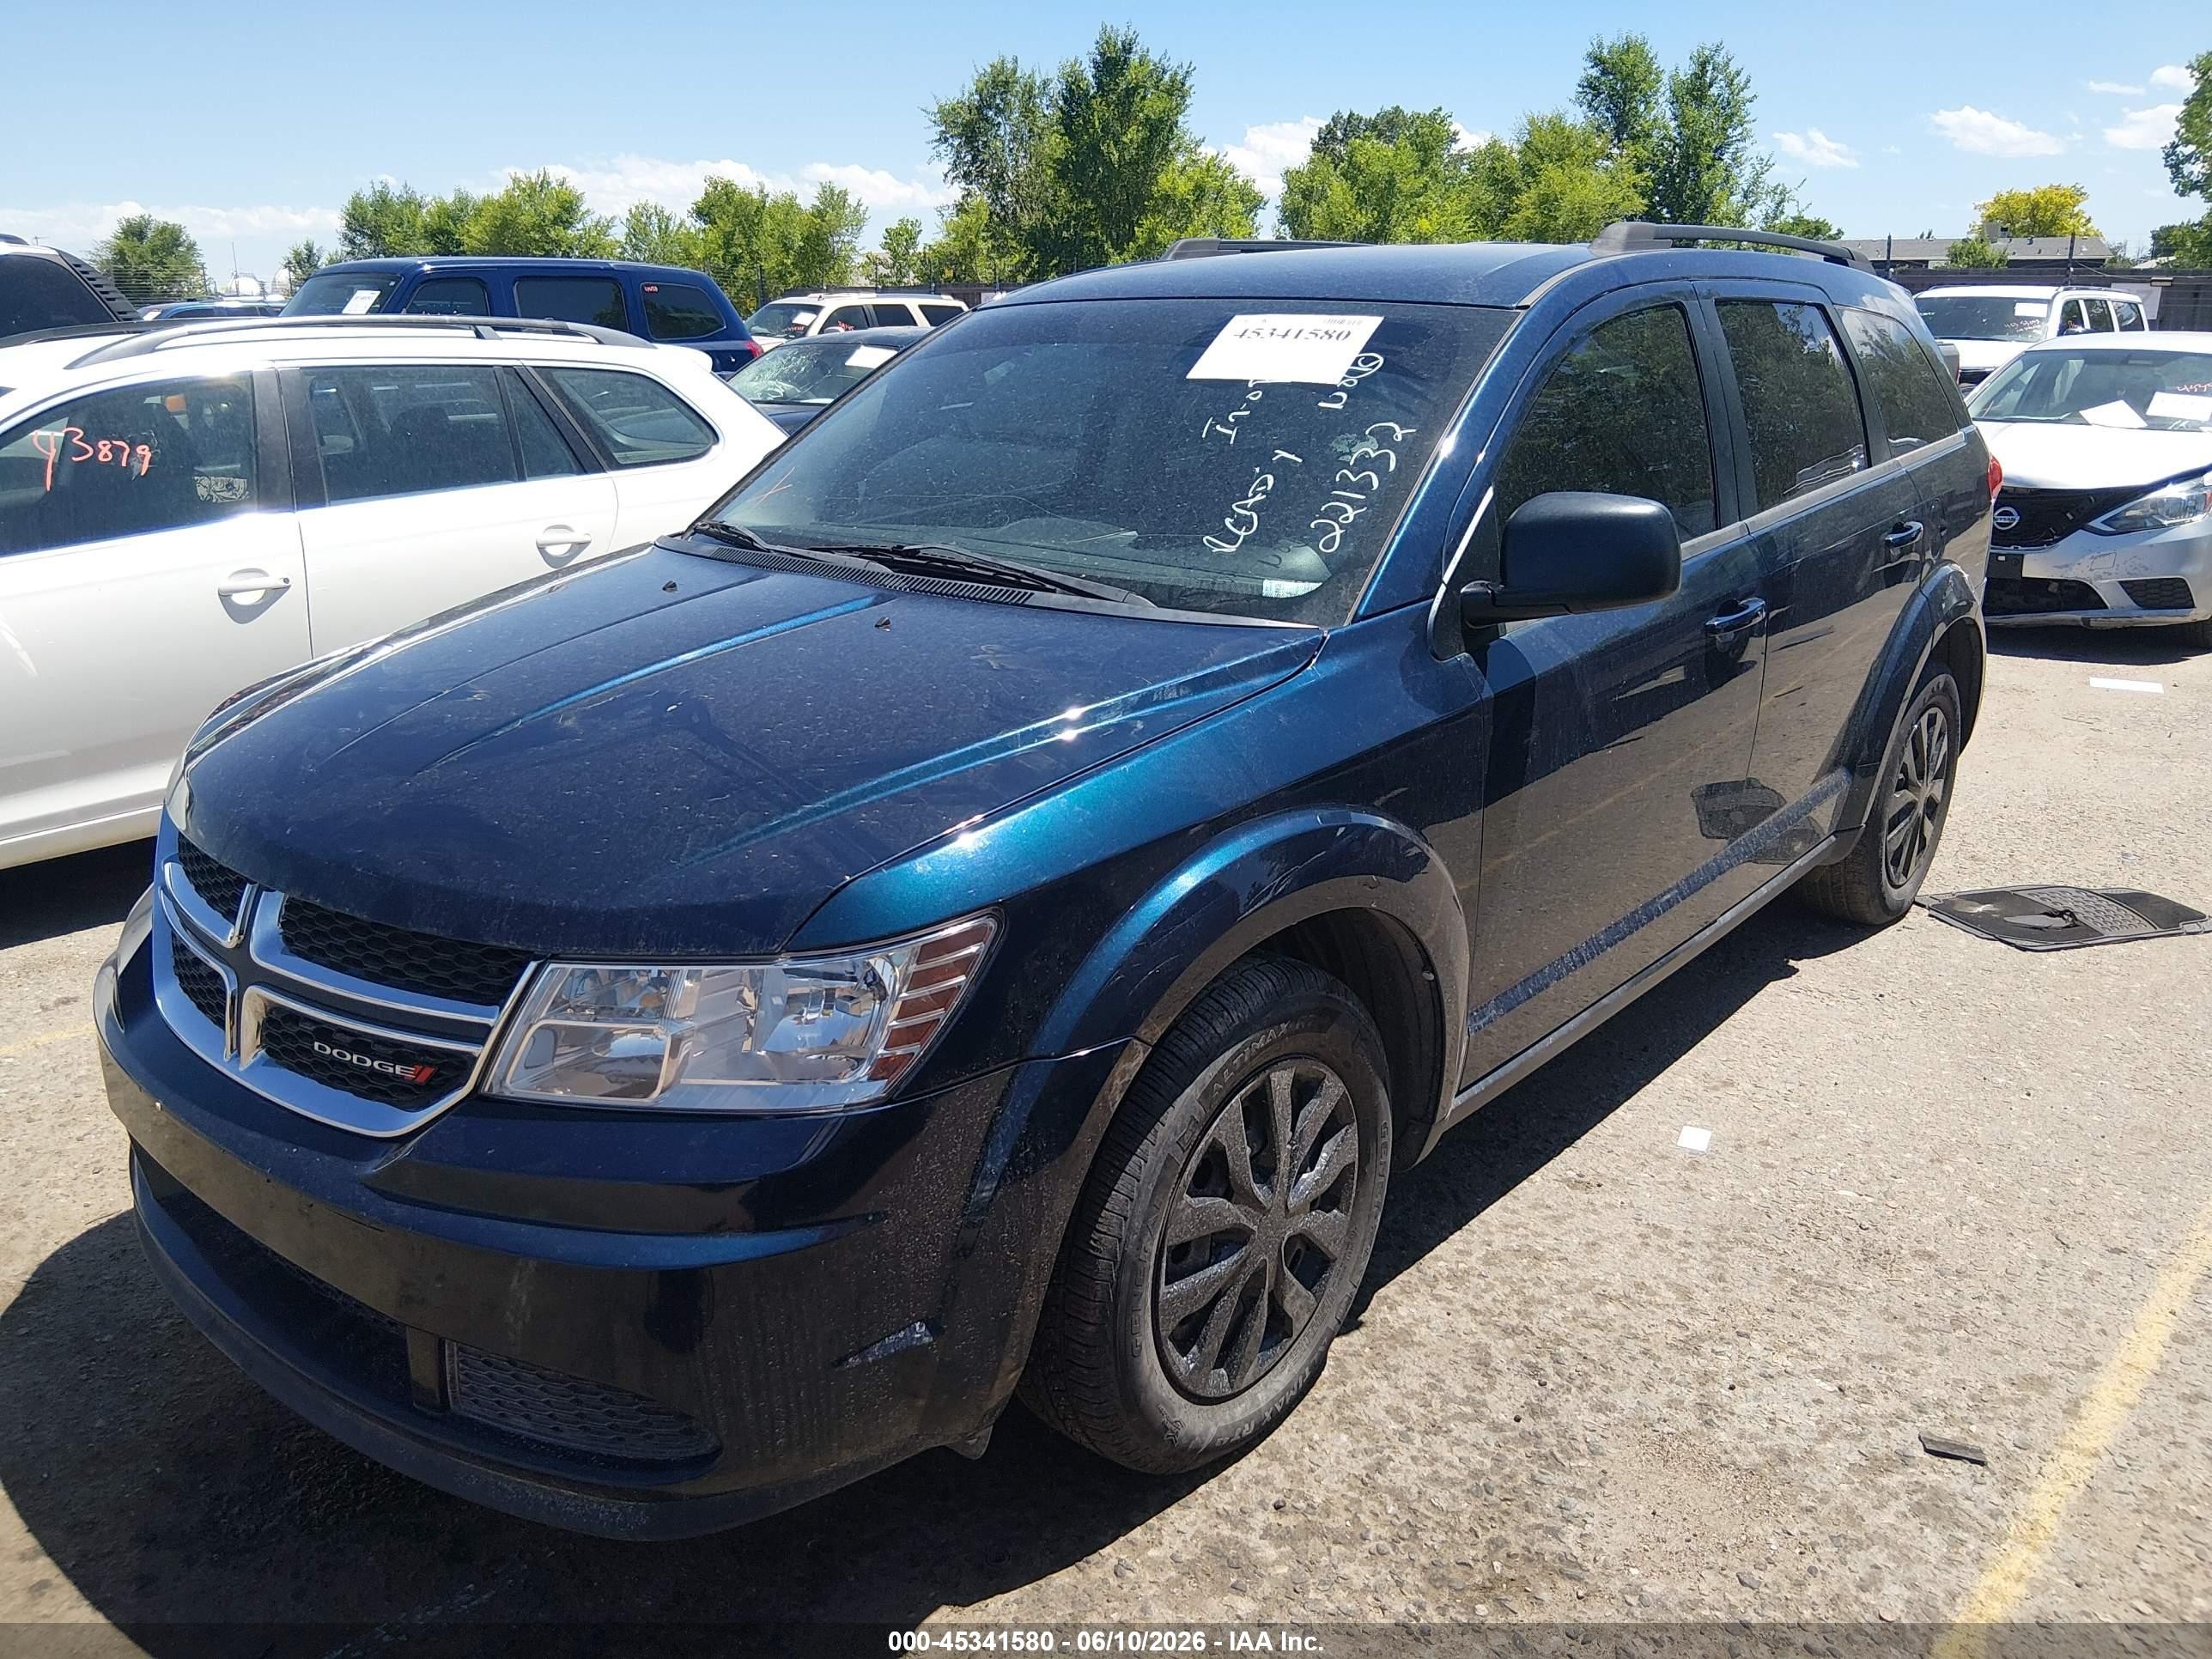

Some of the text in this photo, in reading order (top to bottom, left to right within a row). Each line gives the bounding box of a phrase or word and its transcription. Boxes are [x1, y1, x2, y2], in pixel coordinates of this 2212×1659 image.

[1234, 328, 1352, 341] 45341580
[31, 427, 152, 491] 43879
[1310, 422, 1417, 553] 221332
[313, 1041, 416, 1079] DODGE
